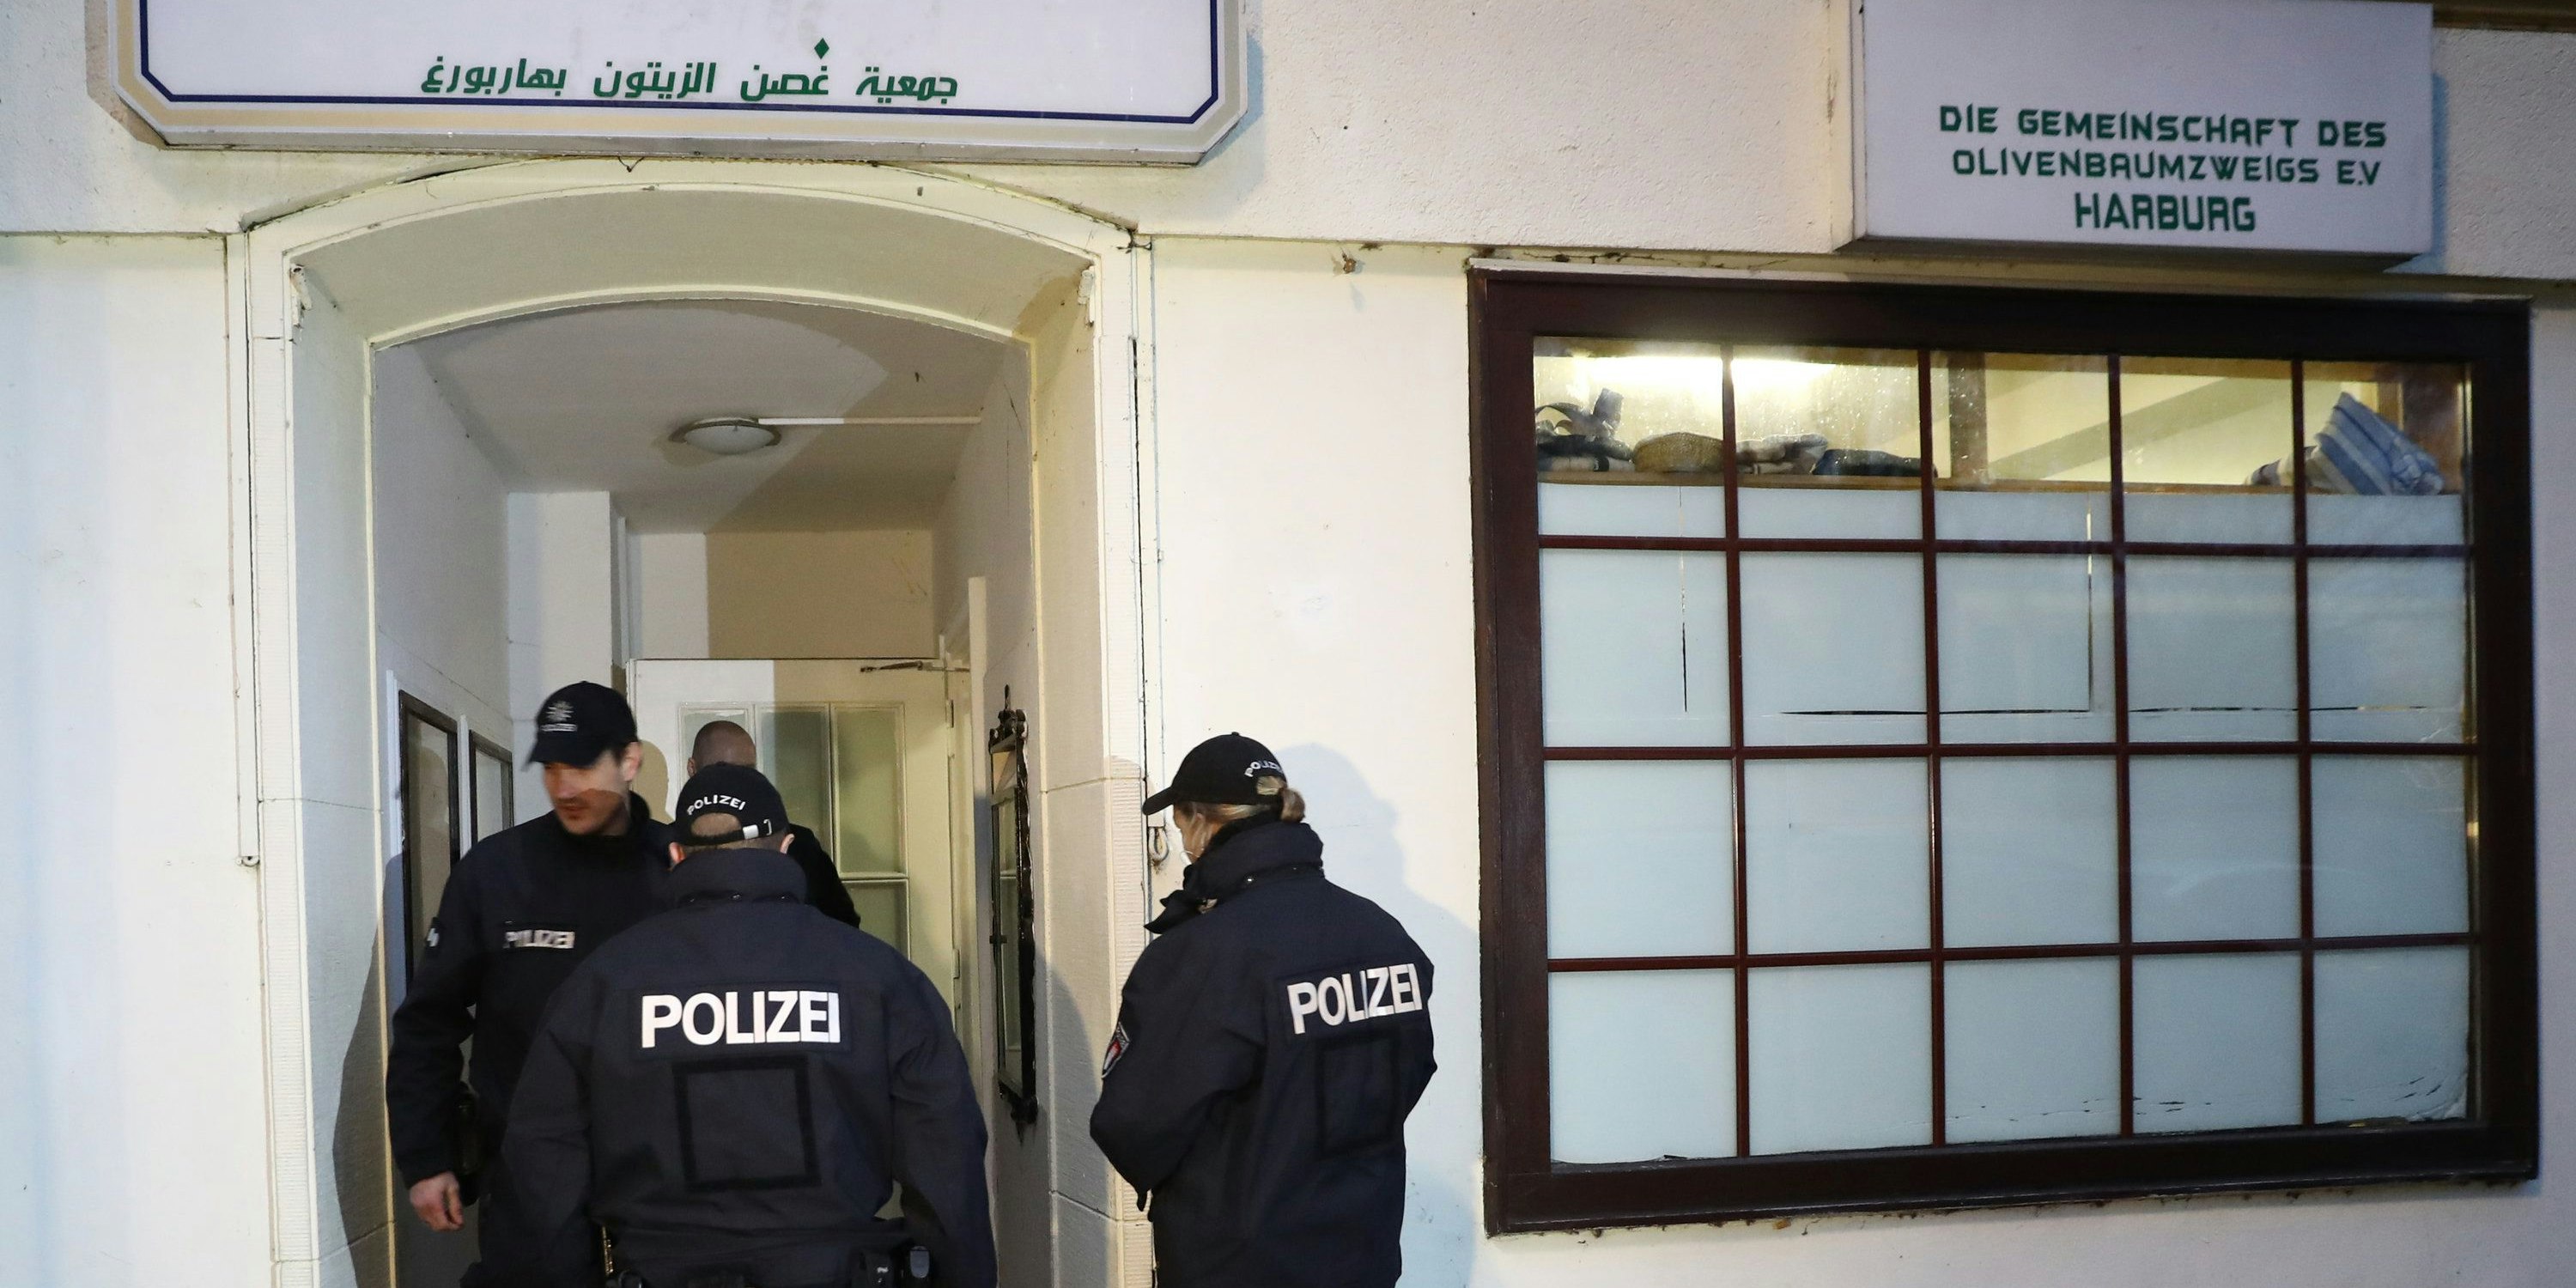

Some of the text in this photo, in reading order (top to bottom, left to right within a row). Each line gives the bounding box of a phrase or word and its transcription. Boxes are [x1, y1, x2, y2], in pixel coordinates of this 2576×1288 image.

[422, 56, 958, 106] جمعية غصن الزيتون بهاربورغ
[1940, 103, 2388, 149] DIE GEMEINSCHAFT DES
[1953, 146, 2320, 184] OLIVENBAUMZWEIGS
[2075, 191, 2257, 233] HARBURG
[687, 794, 746, 816] POLIZEI
[641, 990, 841, 1048] POLIZEI
[1286, 963, 1423, 1035] POLIZEI
